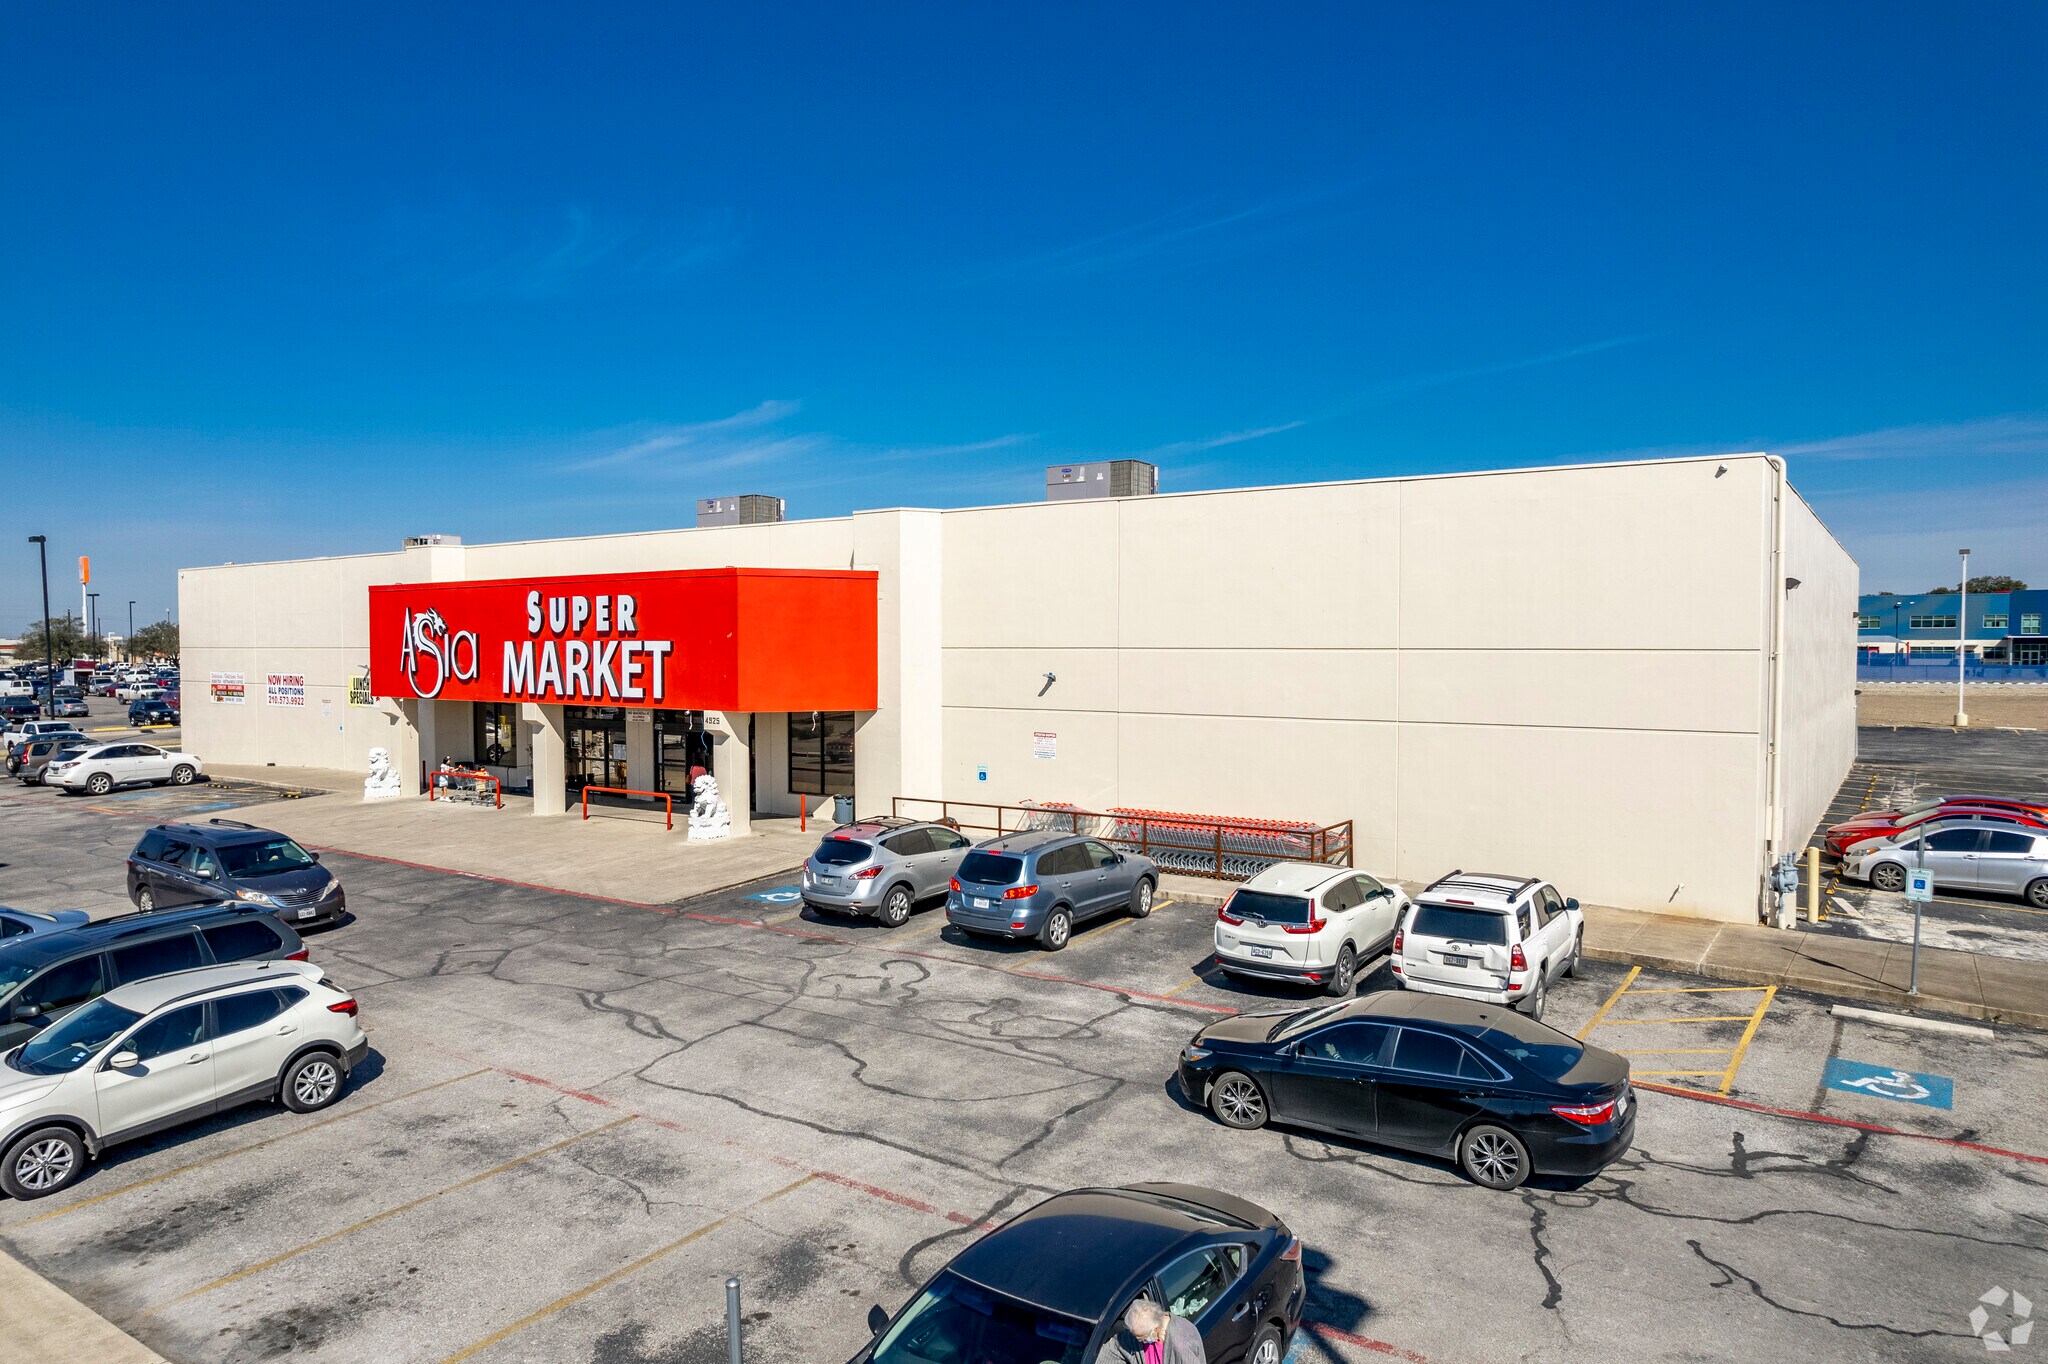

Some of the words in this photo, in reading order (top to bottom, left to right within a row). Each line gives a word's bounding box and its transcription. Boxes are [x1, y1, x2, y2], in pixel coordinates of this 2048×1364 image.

[526, 590, 638, 634] SUPER
[502, 640, 674, 699] MARKET
[267, 674, 281, 685] NOW
[283, 675, 304, 687] HIRING
[353, 677, 370, 691] LUNCH
[268, 687, 277, 695] ALL
[278, 687, 305, 696] POSITIONS
[349, 690, 374, 705] SPECIALS
[268, 695, 305, 706] 210.573.9922
[705, 717, 720, 725] 4925
